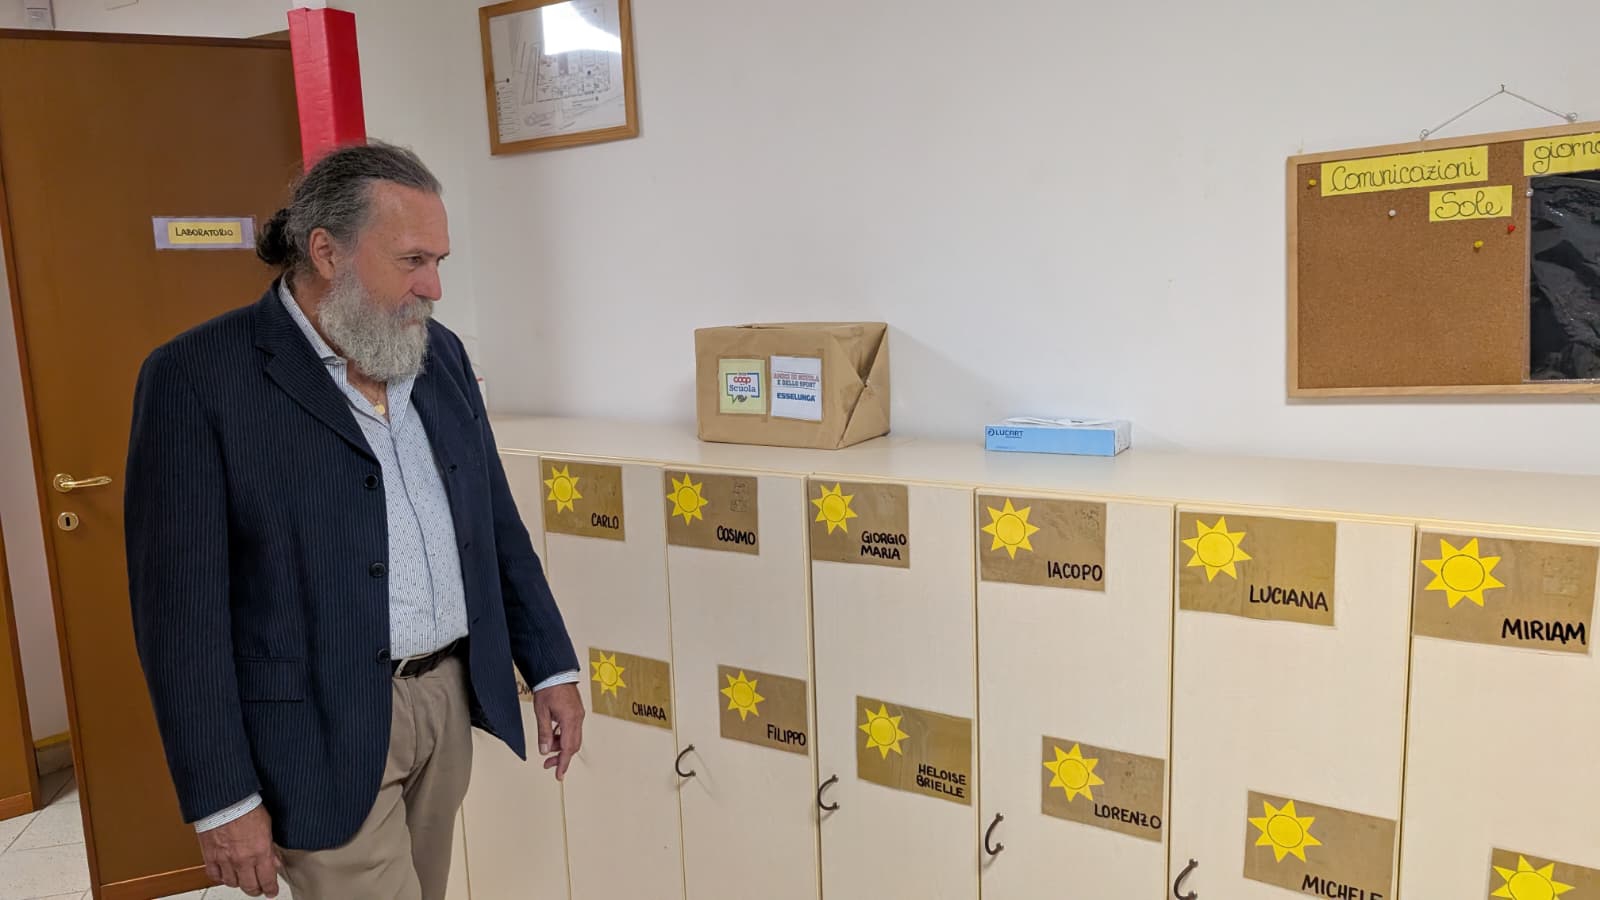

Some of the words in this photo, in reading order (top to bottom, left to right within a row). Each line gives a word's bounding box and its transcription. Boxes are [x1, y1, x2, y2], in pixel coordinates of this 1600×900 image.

[1330, 157, 1480, 192] Comunicazioni
[1435, 190, 1503, 219] Sole
[175, 227, 234, 237] LABORATORIO
[729, 384, 757, 393] Scuola
[733, 376, 752, 385] coop
[777, 392, 816, 402] ESSELUNGA
[591, 513, 619, 530] CARLO
[717, 525, 756, 545] COSIMO
[861, 530, 907, 546] GIORGIO
[860, 545, 901, 560] MARIA
[1047, 561, 1103, 582] IACOPO
[1249, 584, 1329, 612] LUCIANA
[1501, 618, 1586, 645] MIRIAM
[631, 702, 667, 721] CHIARA
[767, 724, 806, 746] FILIPPO
[918, 763, 967, 786] HELOISE
[916, 775, 965, 798] BRIELLE
[1094, 803, 1162, 829] LORENZO
